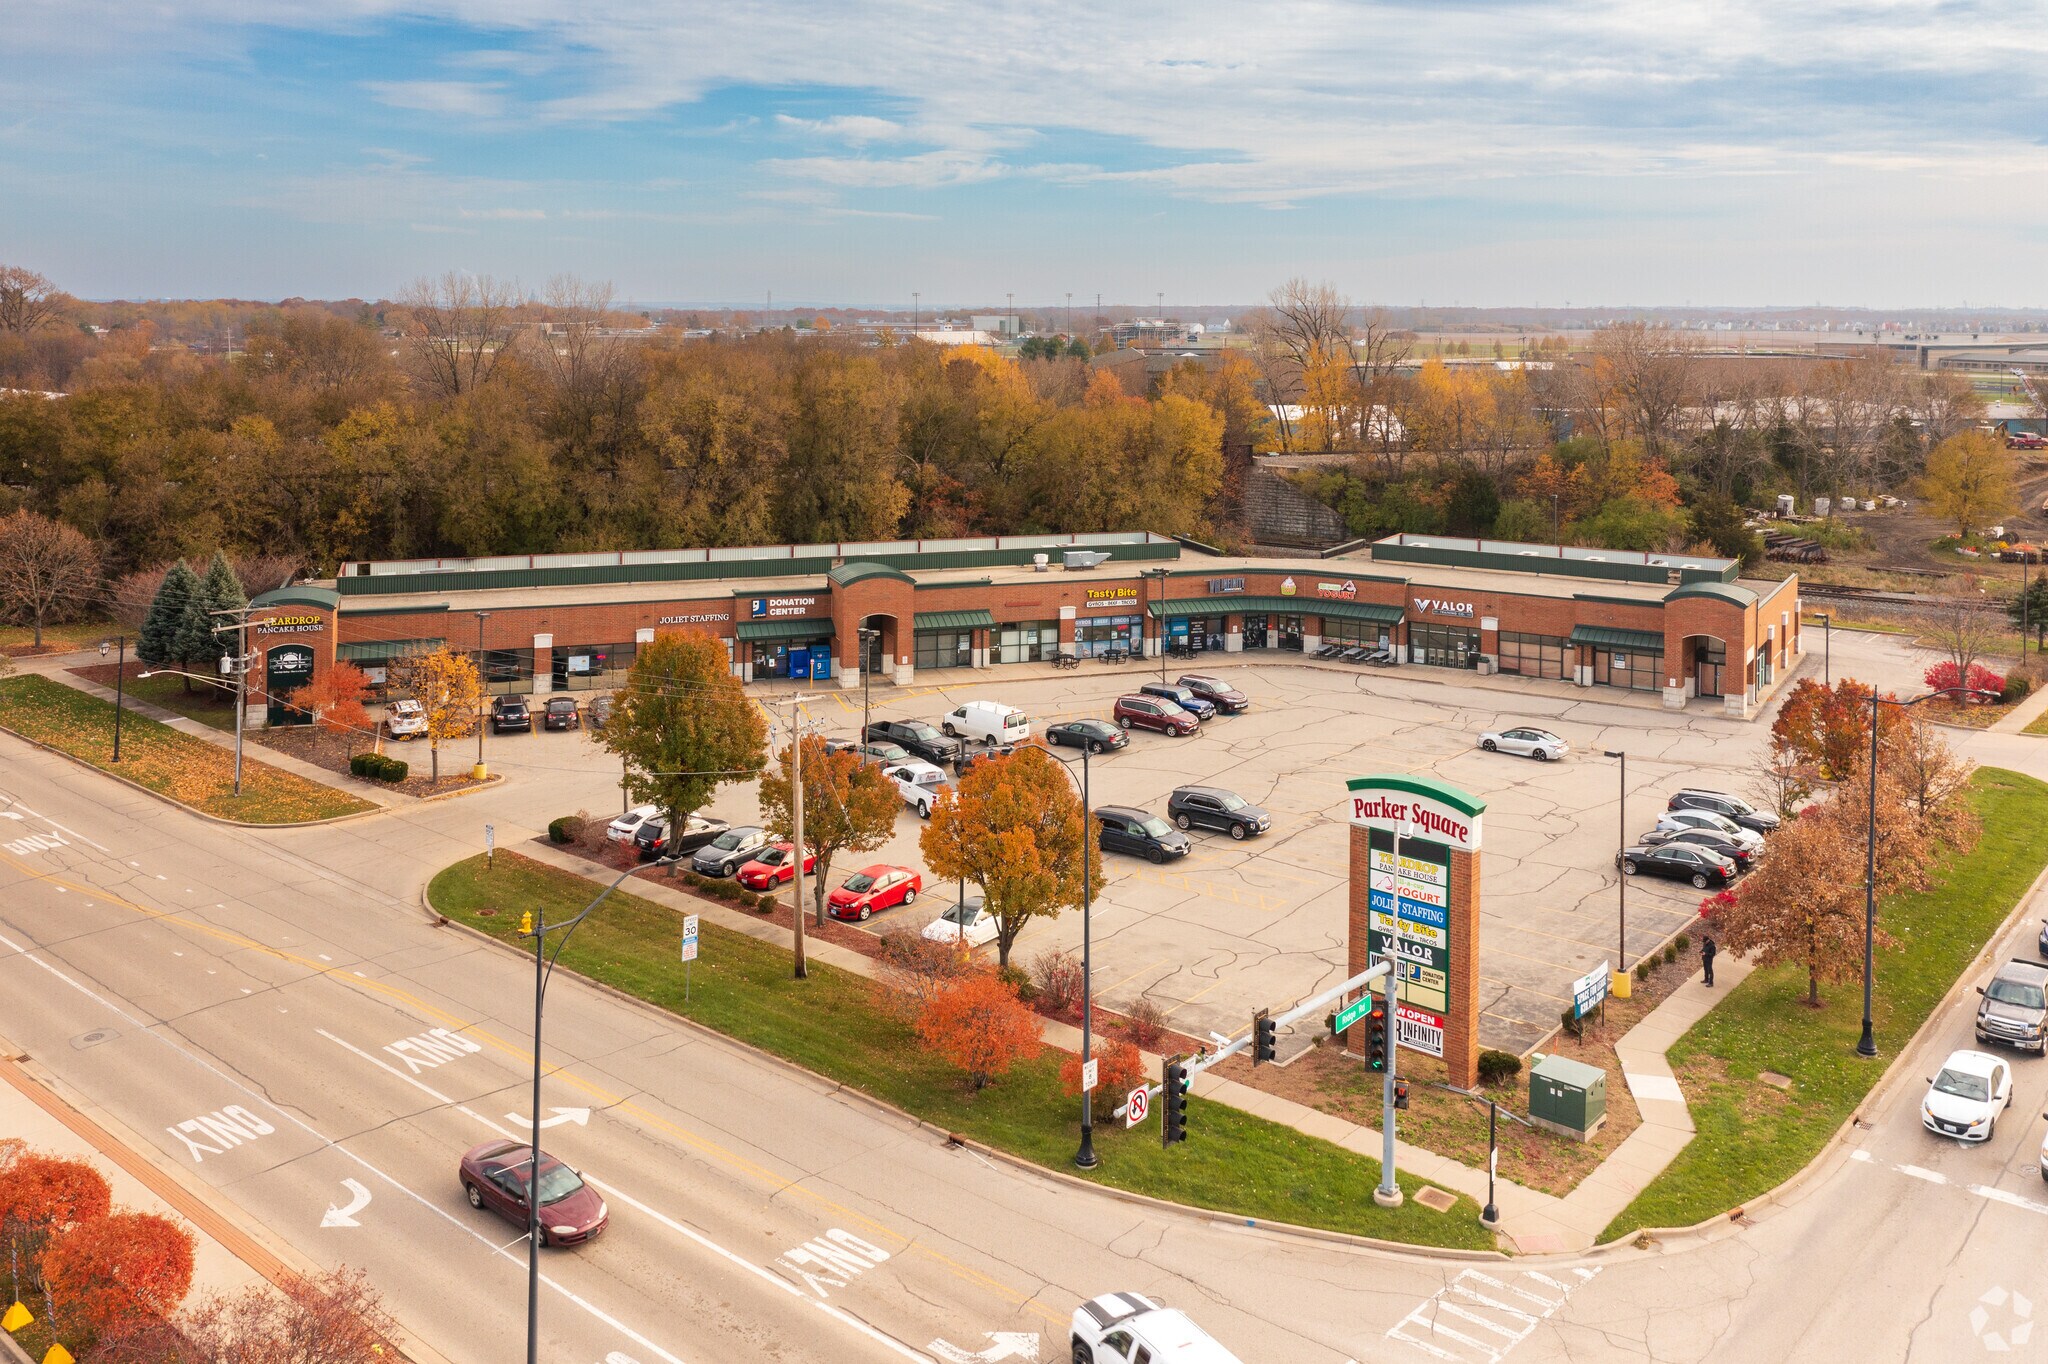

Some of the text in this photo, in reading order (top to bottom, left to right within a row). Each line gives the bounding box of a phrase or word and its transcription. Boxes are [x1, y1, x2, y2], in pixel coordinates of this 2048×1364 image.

[1087, 588, 1137, 599] Tasty Bite
[1317, 589, 1355, 600] YOGURT
[769, 597, 815, 607] DONATION
[1432, 600, 1473, 612] VALOR
[660, 613, 730, 624] JOLIET STAFFING
[769, 607, 806, 616] CENTER
[257, 624, 324, 634] PANCAKE HOUSE
[1353, 796, 1469, 843] Parker Square
[1379, 852, 1438, 875] TERDROP
[1379, 863, 1438, 883] PANAKE HOUSE
[1397, 886, 1441, 904] YOGURT
[1401, 903, 1444, 923] STAFFING
[685, 926, 696, 936] 30
[1378, 913, 1438, 939] Taty Bite
[1419, 937, 1438, 946] TACOS
[1422, 970, 1444, 981] DONATION
[1422, 976, 1440, 985] CENTER
[1342, 1003, 1366, 1025] Ridge Rd
[1406, 1010, 1435, 1025] OPEN
[1404, 1021, 1441, 1046] INFINITY
[383, 1027, 482, 1074] ONLY
[166, 1104, 275, 1163] ONLY
[775, 1228, 891, 1298] ONLY
